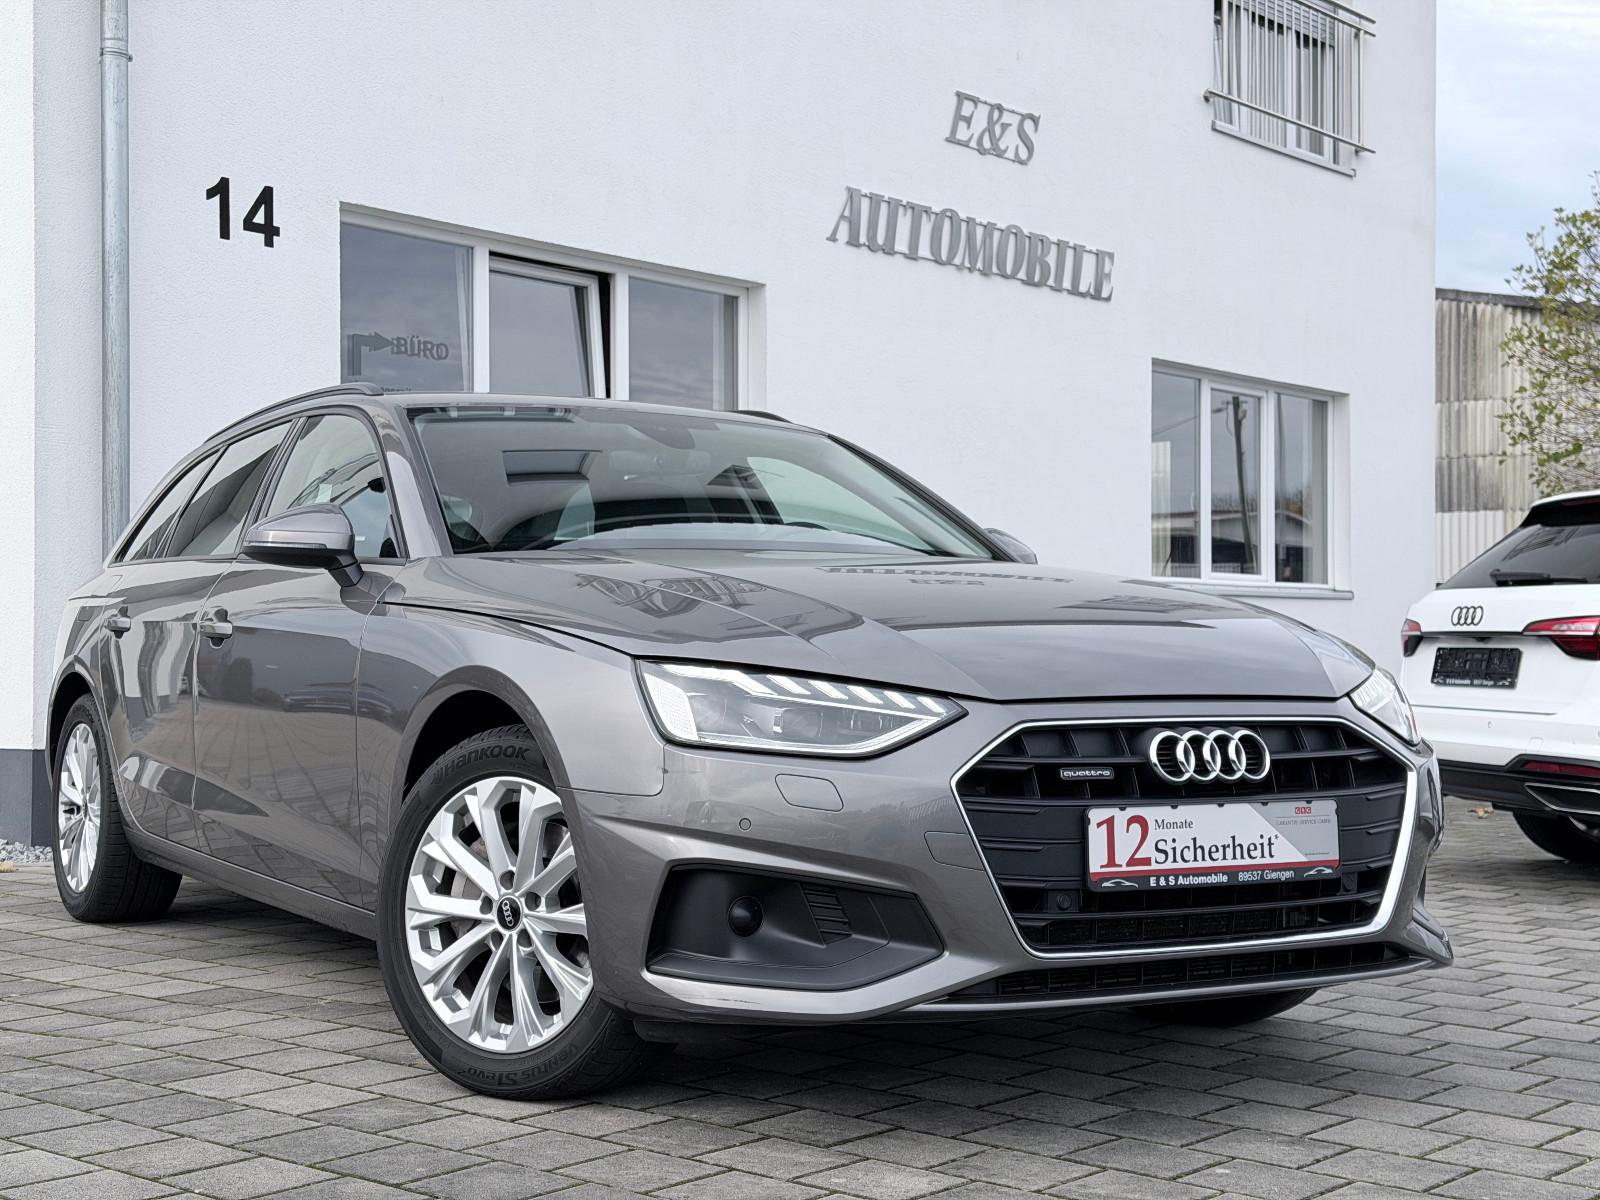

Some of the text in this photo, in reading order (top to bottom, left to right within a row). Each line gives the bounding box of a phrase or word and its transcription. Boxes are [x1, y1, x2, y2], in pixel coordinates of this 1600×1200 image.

[945, 90, 1041, 166] E&S
[205, 176, 281, 249] 14
[826, 186, 1115, 302] AUTOMOBILE
[391, 335, 450, 361] BÜRO
[1063, 770, 1111, 778] quattro
[1096, 815, 1194, 869] 12 Monate
[1150, 869, 1295, 887] E & S Automobile 89537 Giengen
